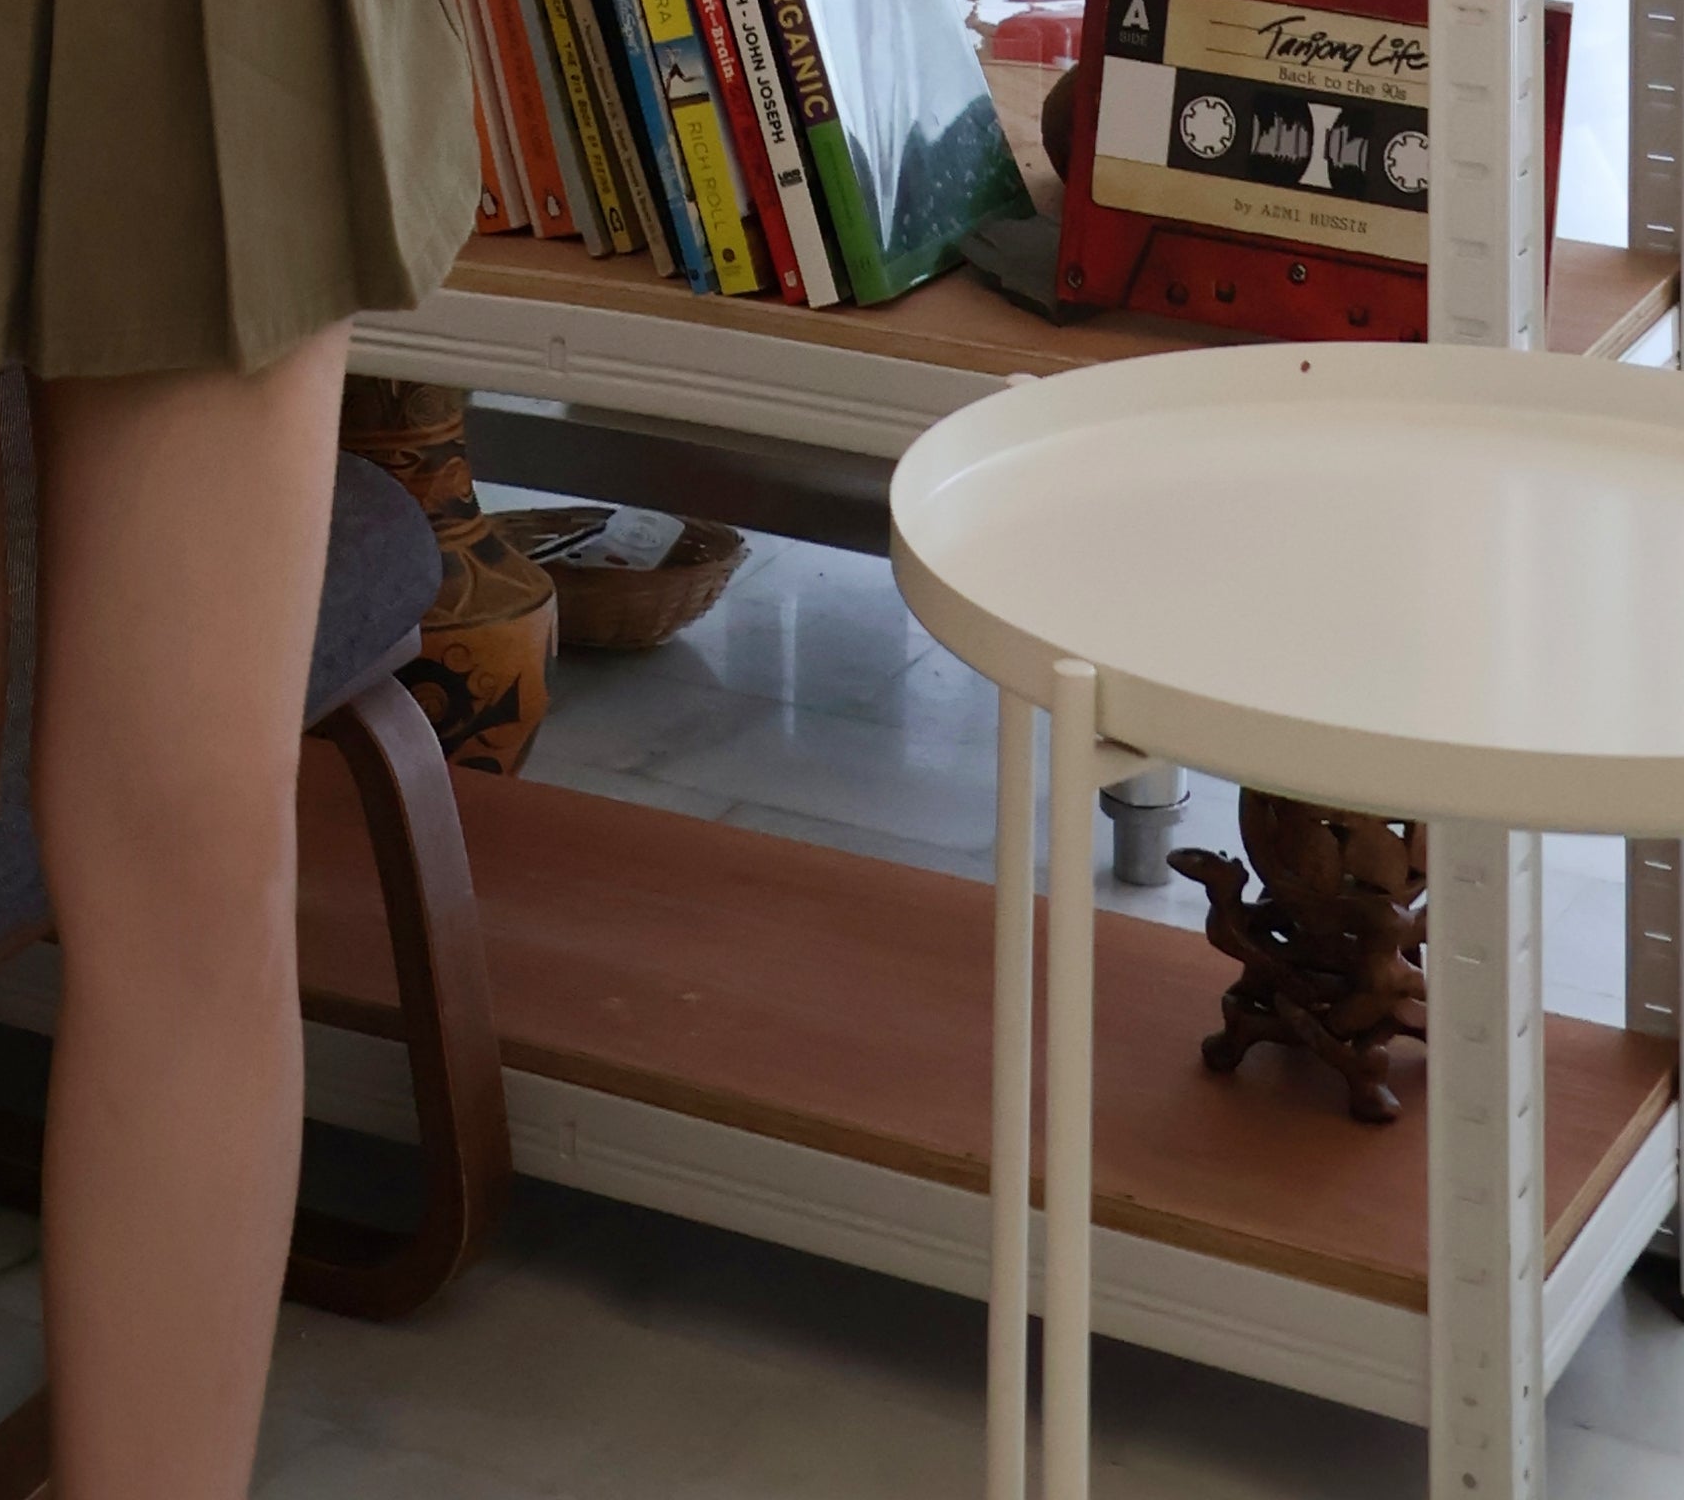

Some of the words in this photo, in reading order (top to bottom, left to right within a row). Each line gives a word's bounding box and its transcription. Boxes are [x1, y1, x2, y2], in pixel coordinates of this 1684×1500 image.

[1119, 30, 1148, 46] SIDE
[1258, 14, 1363, 73] Tanjong
[1367, 35, 1428, 74] Life
[742, 21, 766, 72] JOHN
[757, 75, 785, 145] JOSEPH
[1278, 66, 1317, 86] Back
[1325, 73, 1342, 90] to
[1343, 76, 1376, 96] the
[1382, 82, 1407, 101] 90s
[687, 121, 714, 172] RICH
[706, 176, 726, 231] ROLL
[1234, 199, 1253, 217] by
